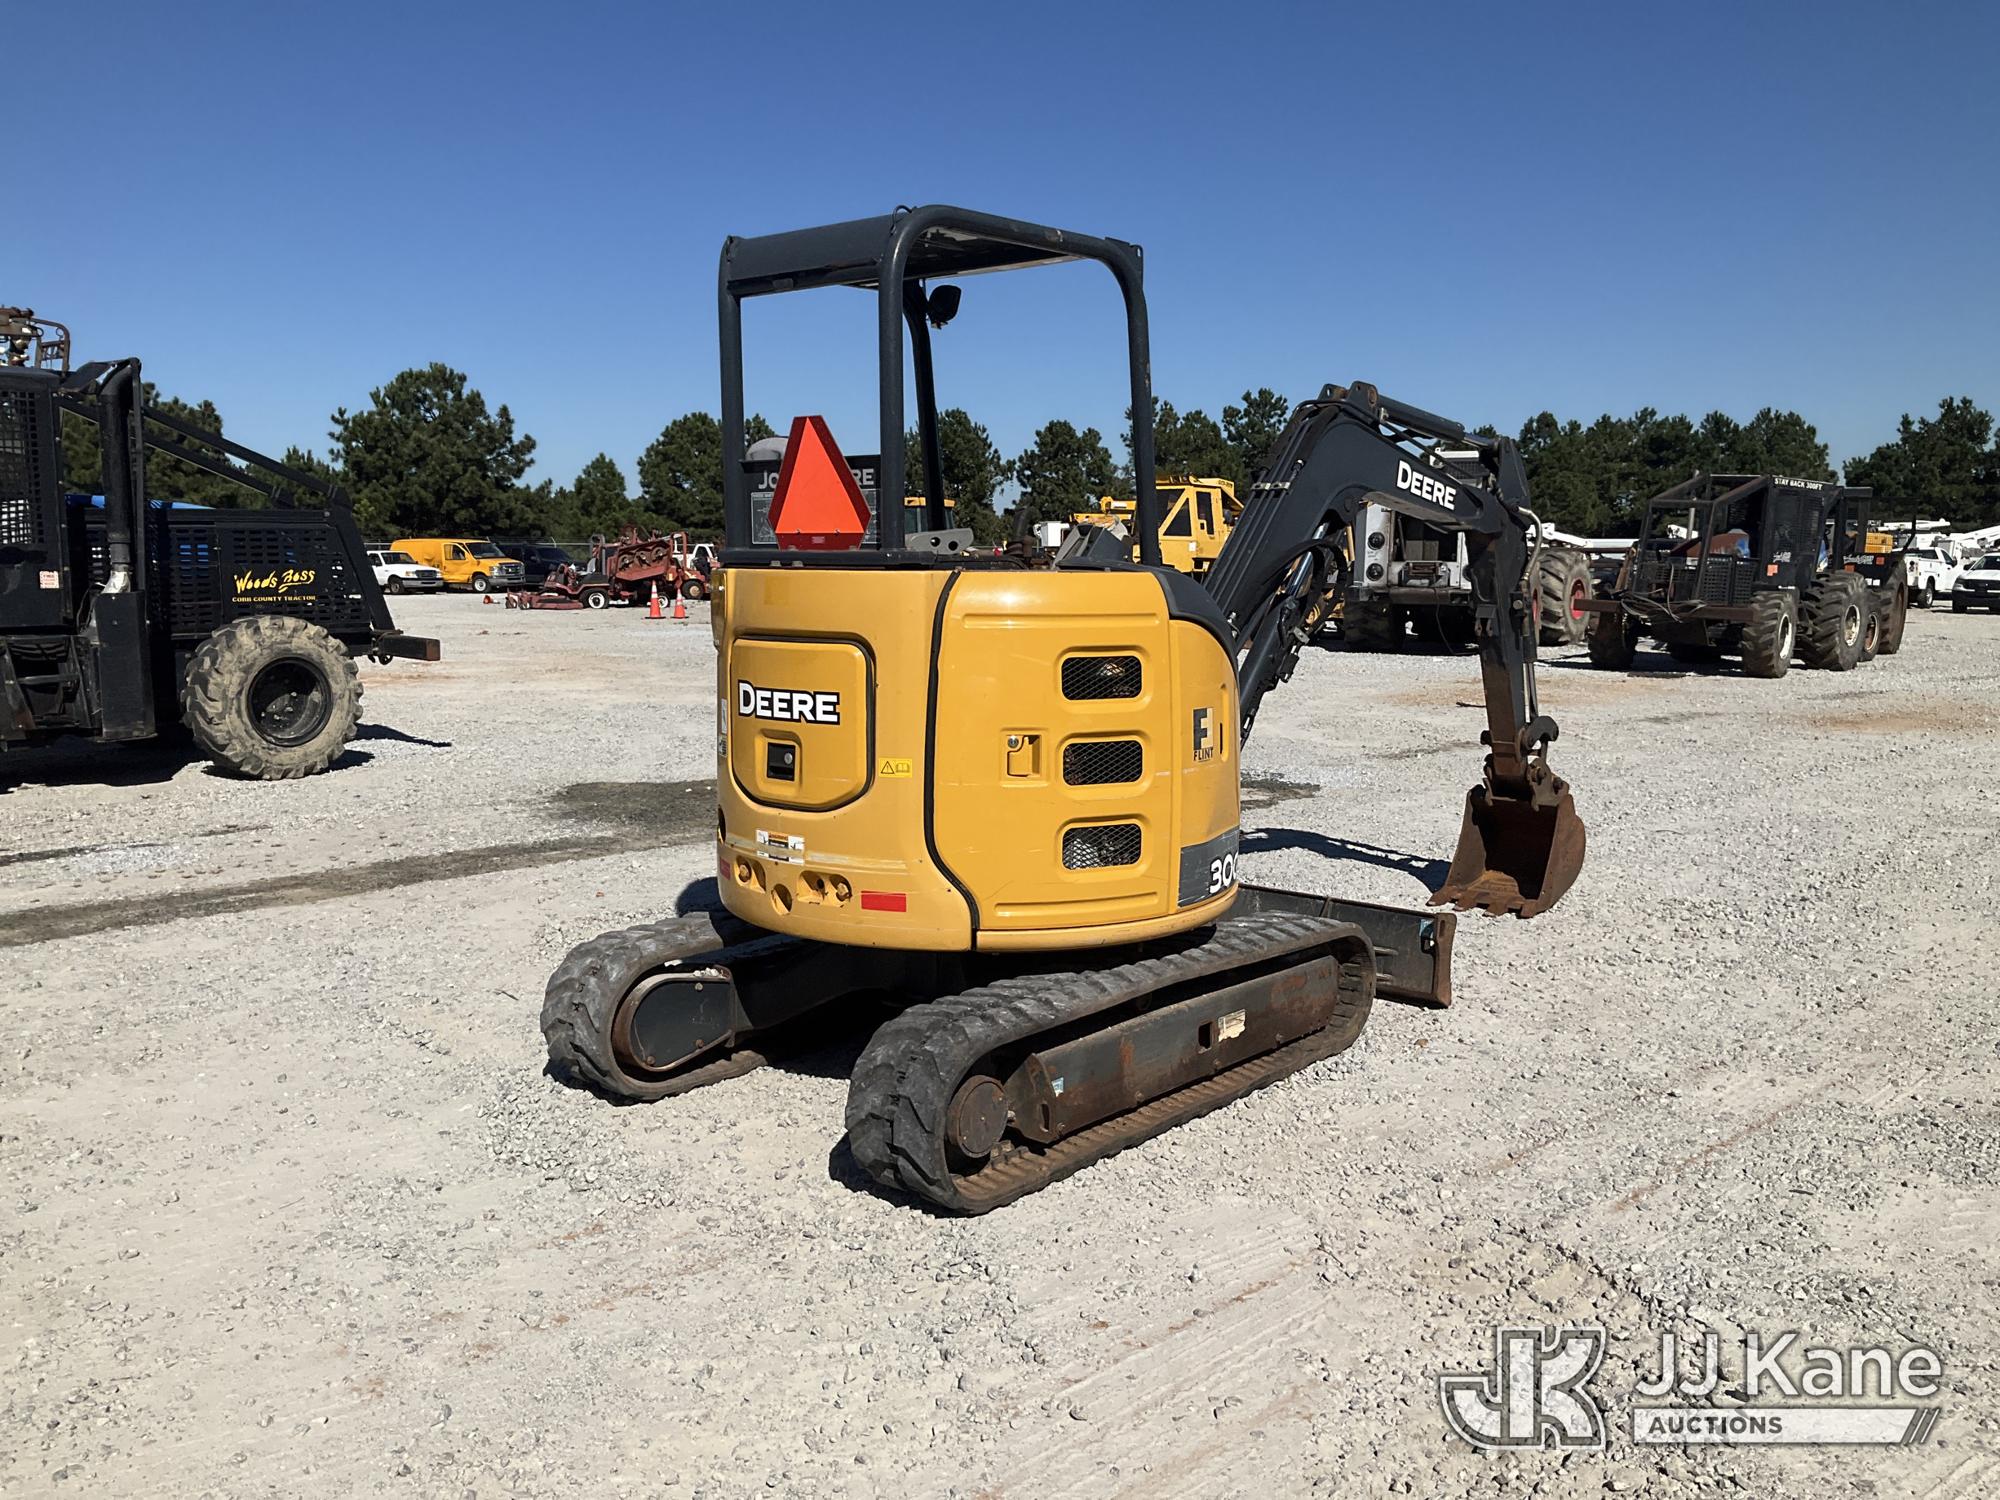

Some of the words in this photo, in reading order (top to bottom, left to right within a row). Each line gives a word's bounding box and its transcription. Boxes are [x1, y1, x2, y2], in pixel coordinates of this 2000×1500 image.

[1396, 460, 1457, 510] DEERE
[1774, 478, 1789, 486] STAY
[1790, 480, 1805, 488] BACK
[234, 571, 278, 594] Woods
[738, 681, 840, 725] DEERE
[1193, 747, 1213, 761] FLINT
